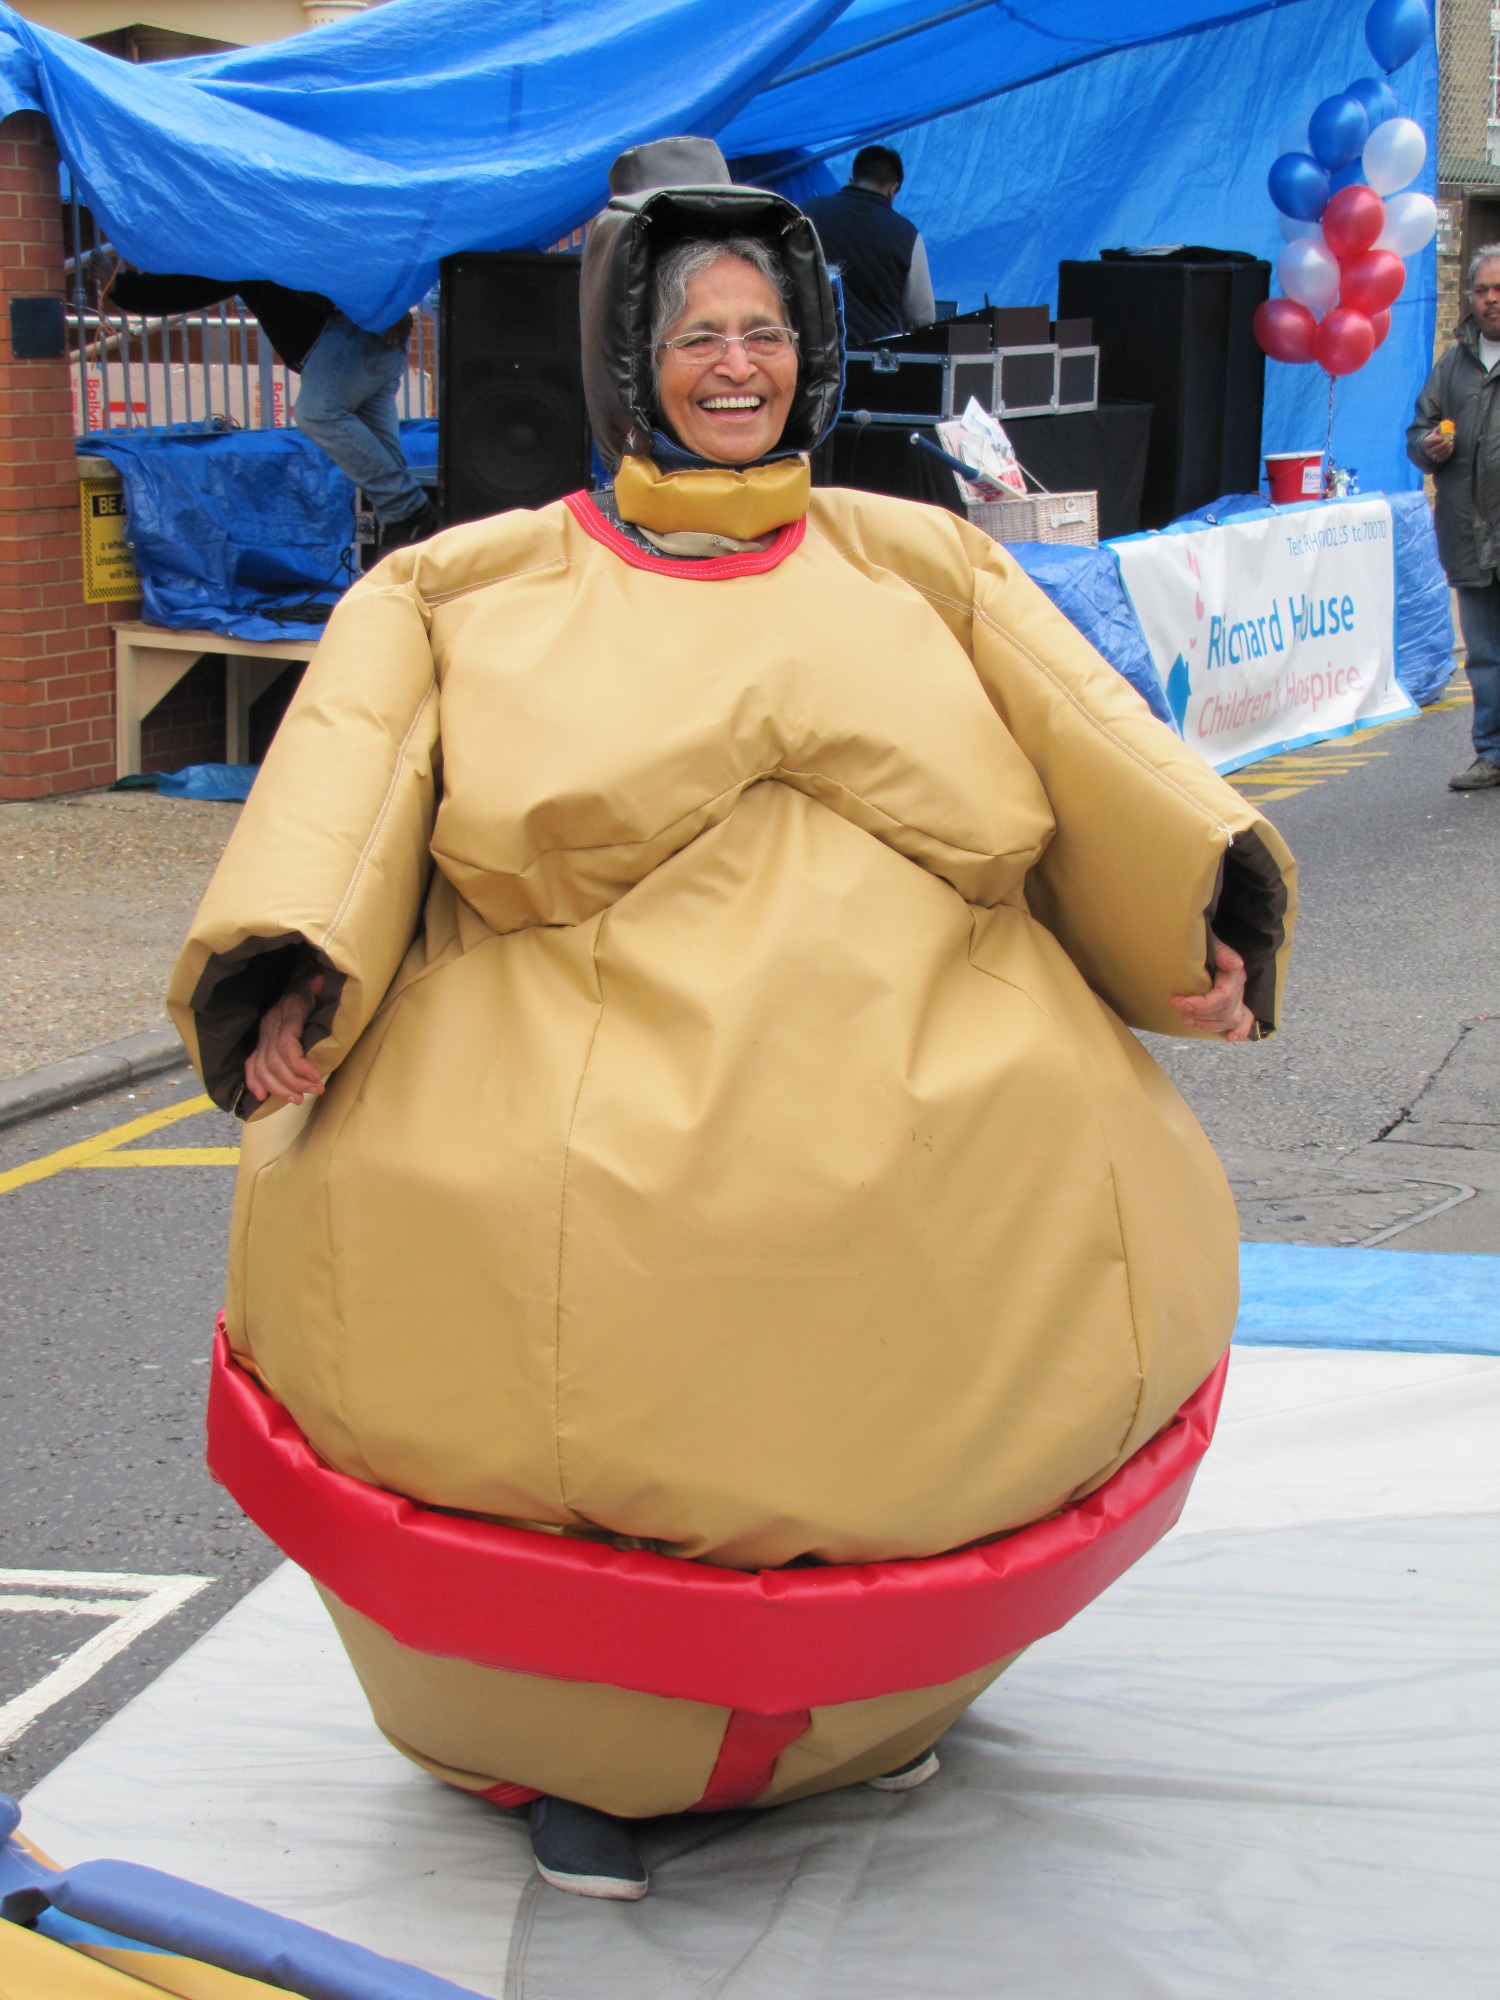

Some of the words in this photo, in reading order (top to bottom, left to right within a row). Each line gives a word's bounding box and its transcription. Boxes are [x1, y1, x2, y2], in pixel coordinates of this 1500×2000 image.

[98, 496, 117, 515] BE
[1363, 520, 1386, 540] 70070
[1207, 598, 1284, 670] Richard
[1198, 678, 1281, 738] Children's
[1286, 661, 1365, 713] Hospice
